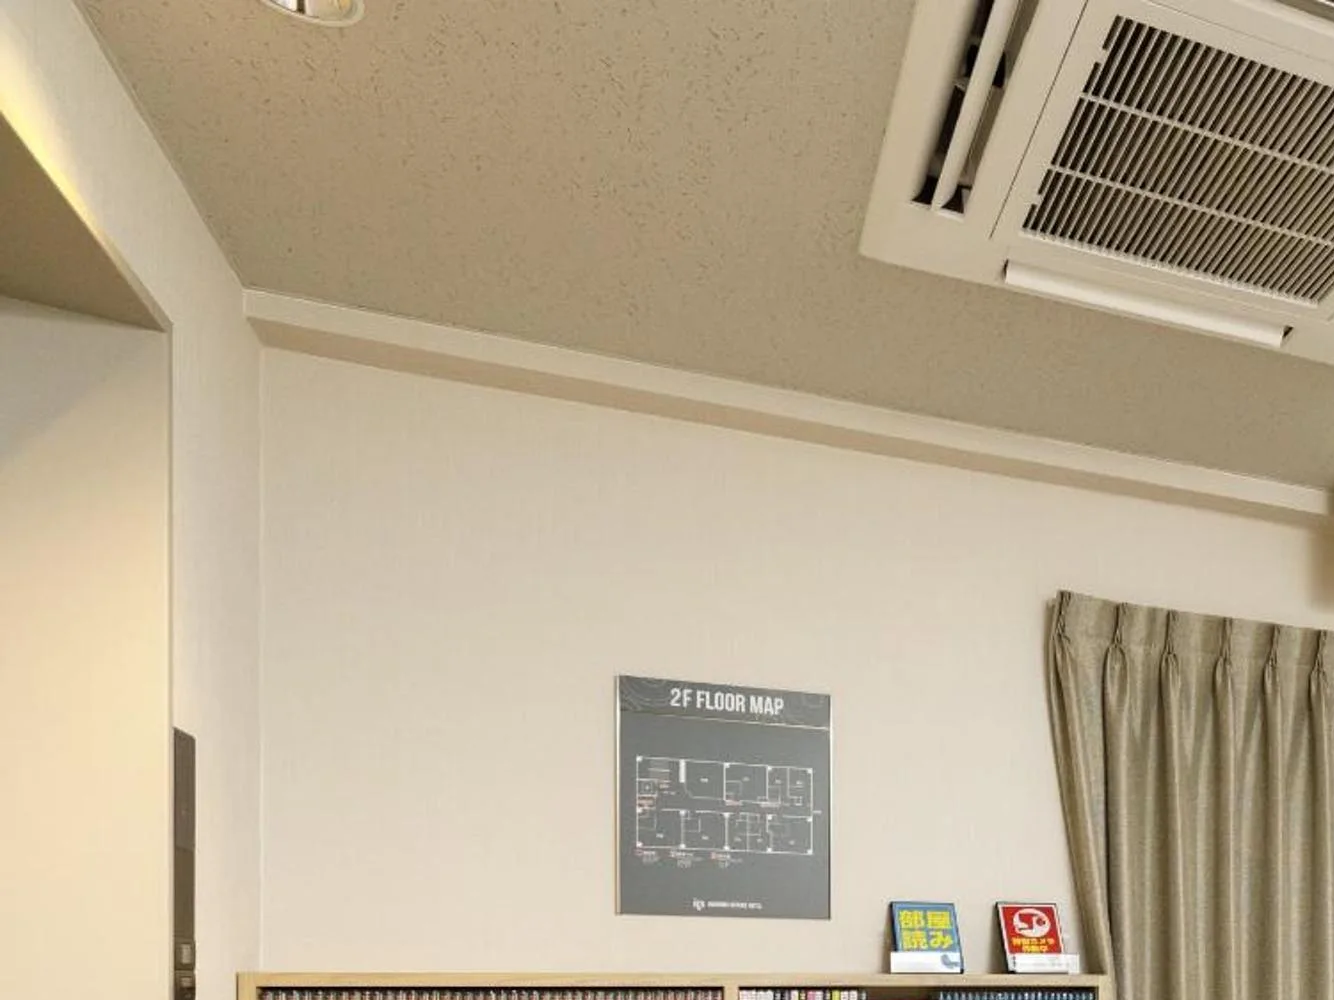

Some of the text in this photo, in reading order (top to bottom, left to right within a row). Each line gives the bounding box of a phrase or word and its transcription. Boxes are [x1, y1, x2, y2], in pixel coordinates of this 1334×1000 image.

[670, 687, 785, 716] 2F FLOOR MAP
